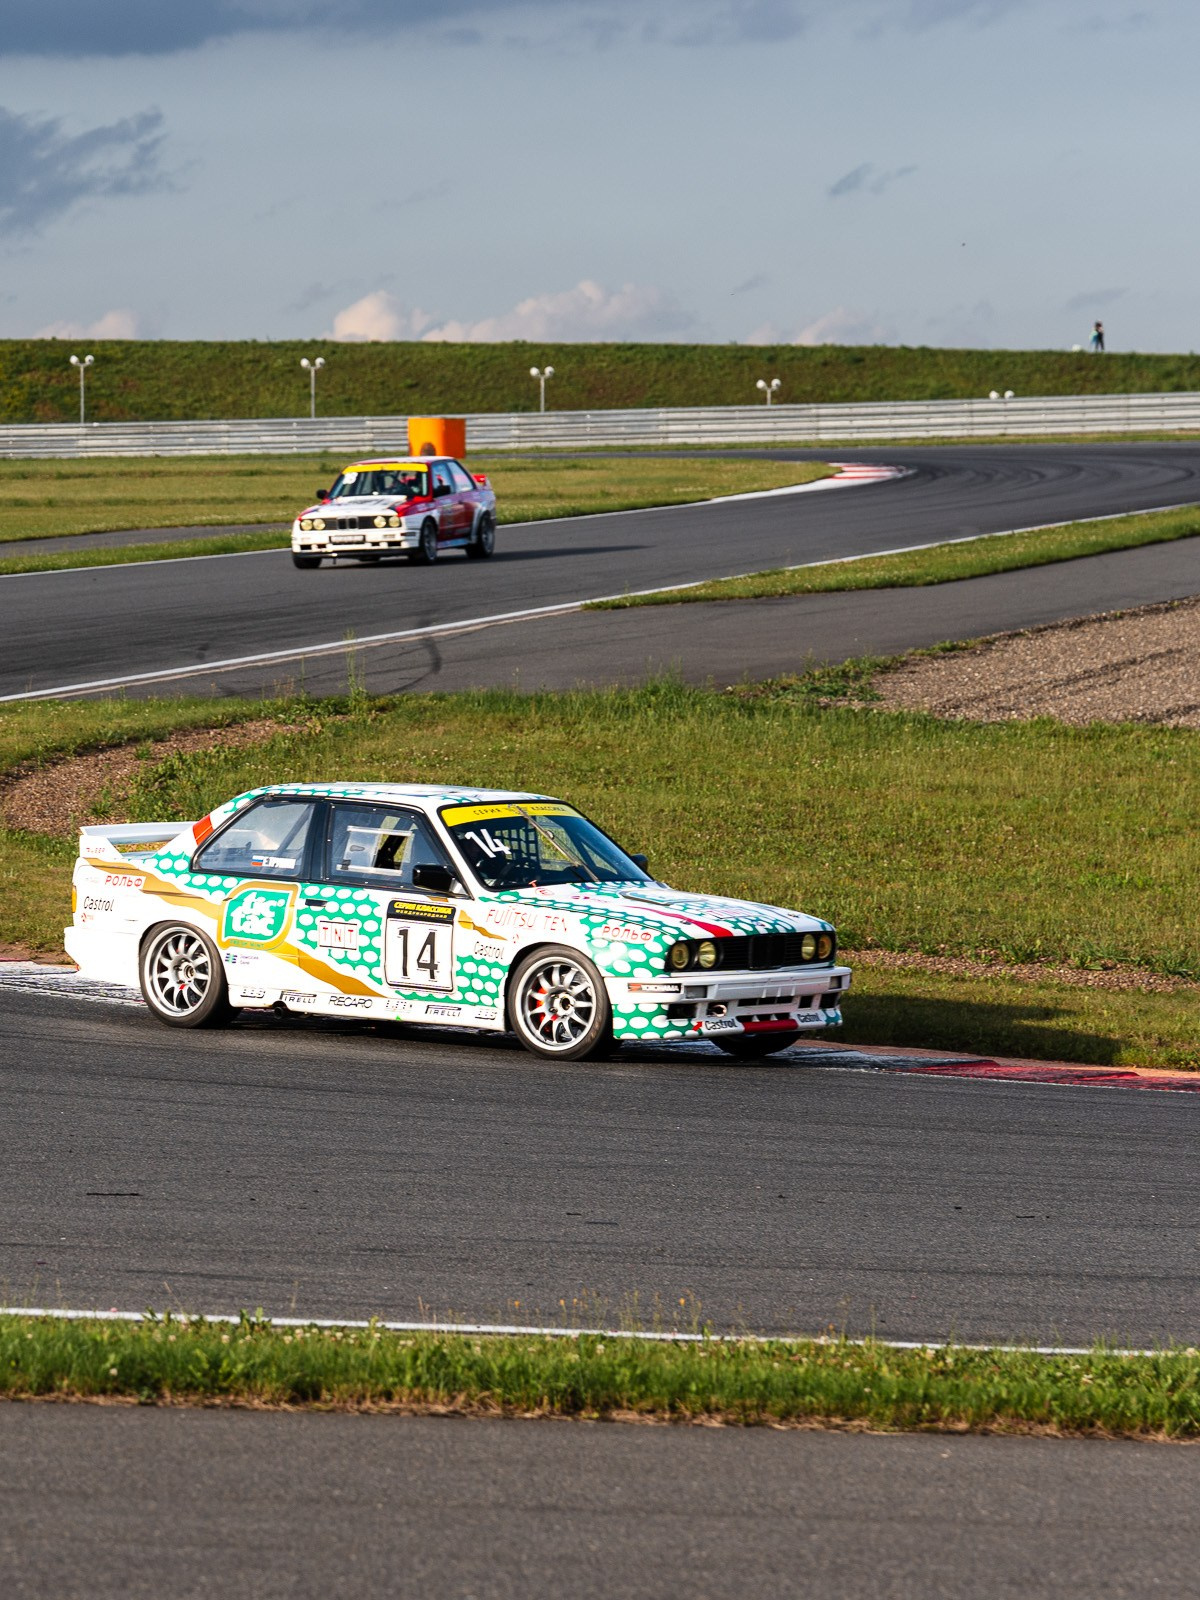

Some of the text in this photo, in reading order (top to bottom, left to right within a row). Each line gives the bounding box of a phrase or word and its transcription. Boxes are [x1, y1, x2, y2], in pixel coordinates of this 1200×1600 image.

[464, 829, 512, 858] 14
[104, 875, 144, 888] РОЛЬФ
[83, 895, 115, 912] Castrol
[230, 906, 275, 937] tac
[322, 926, 354, 944] TNT
[602, 925, 652, 941] РОЛЬФ
[398, 927, 441, 981] 14
[473, 940, 505, 960] Castrol
[278, 990, 318, 1005] PIRELLI
[328, 995, 373, 1009] RECARO
[424, 1004, 463, 1018] PIRELLI
[798, 1012, 822, 1024] Castrol
[704, 1017, 738, 1031] Castrol
